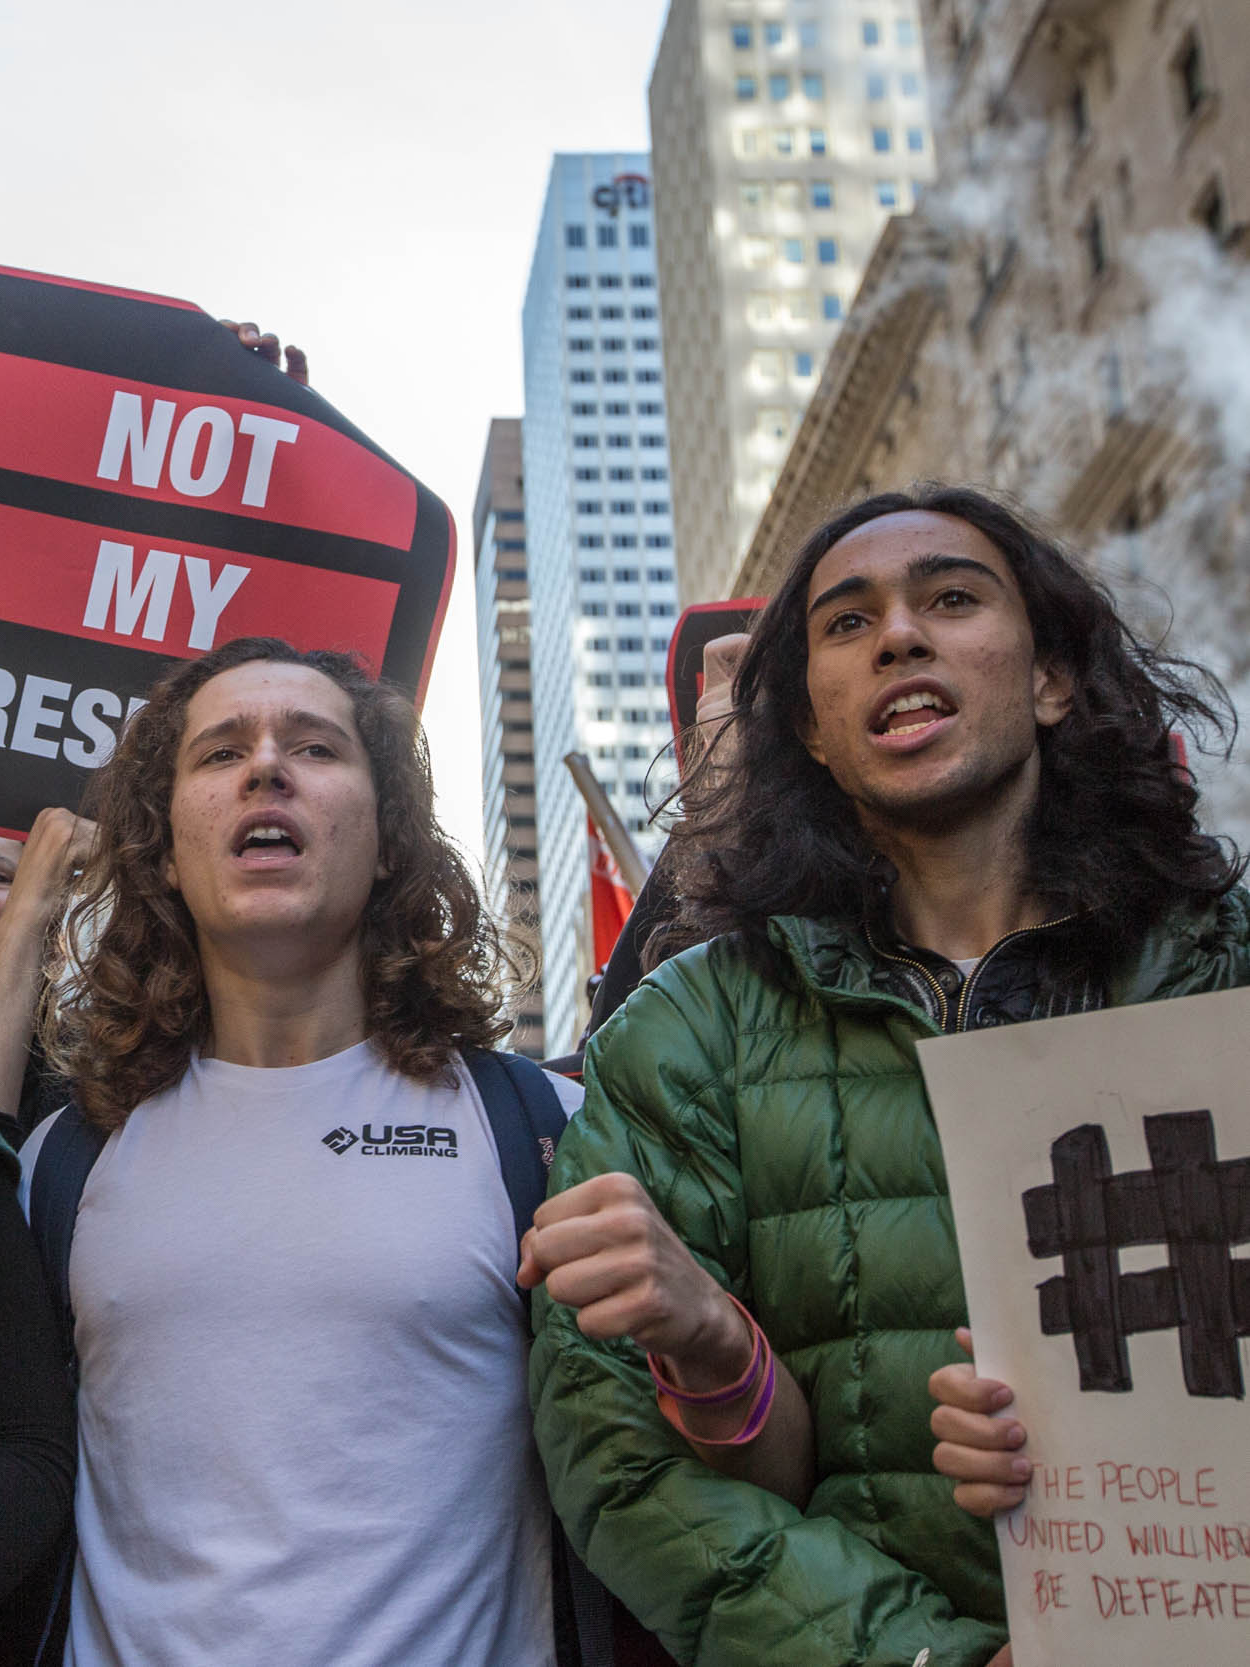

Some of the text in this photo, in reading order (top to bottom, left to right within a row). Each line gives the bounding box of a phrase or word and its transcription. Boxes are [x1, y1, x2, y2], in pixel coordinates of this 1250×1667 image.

[96, 390, 300, 508] NOT
[82, 540, 251, 651] MY
[361, 1145, 458, 1158] CLIMBING
[362, 1124, 458, 1148] USA
[1097, 1461, 1218, 1508] PEOPLE
[1008, 1516, 1104, 1554] UNITED
[1034, 1569, 1070, 1614] BE
